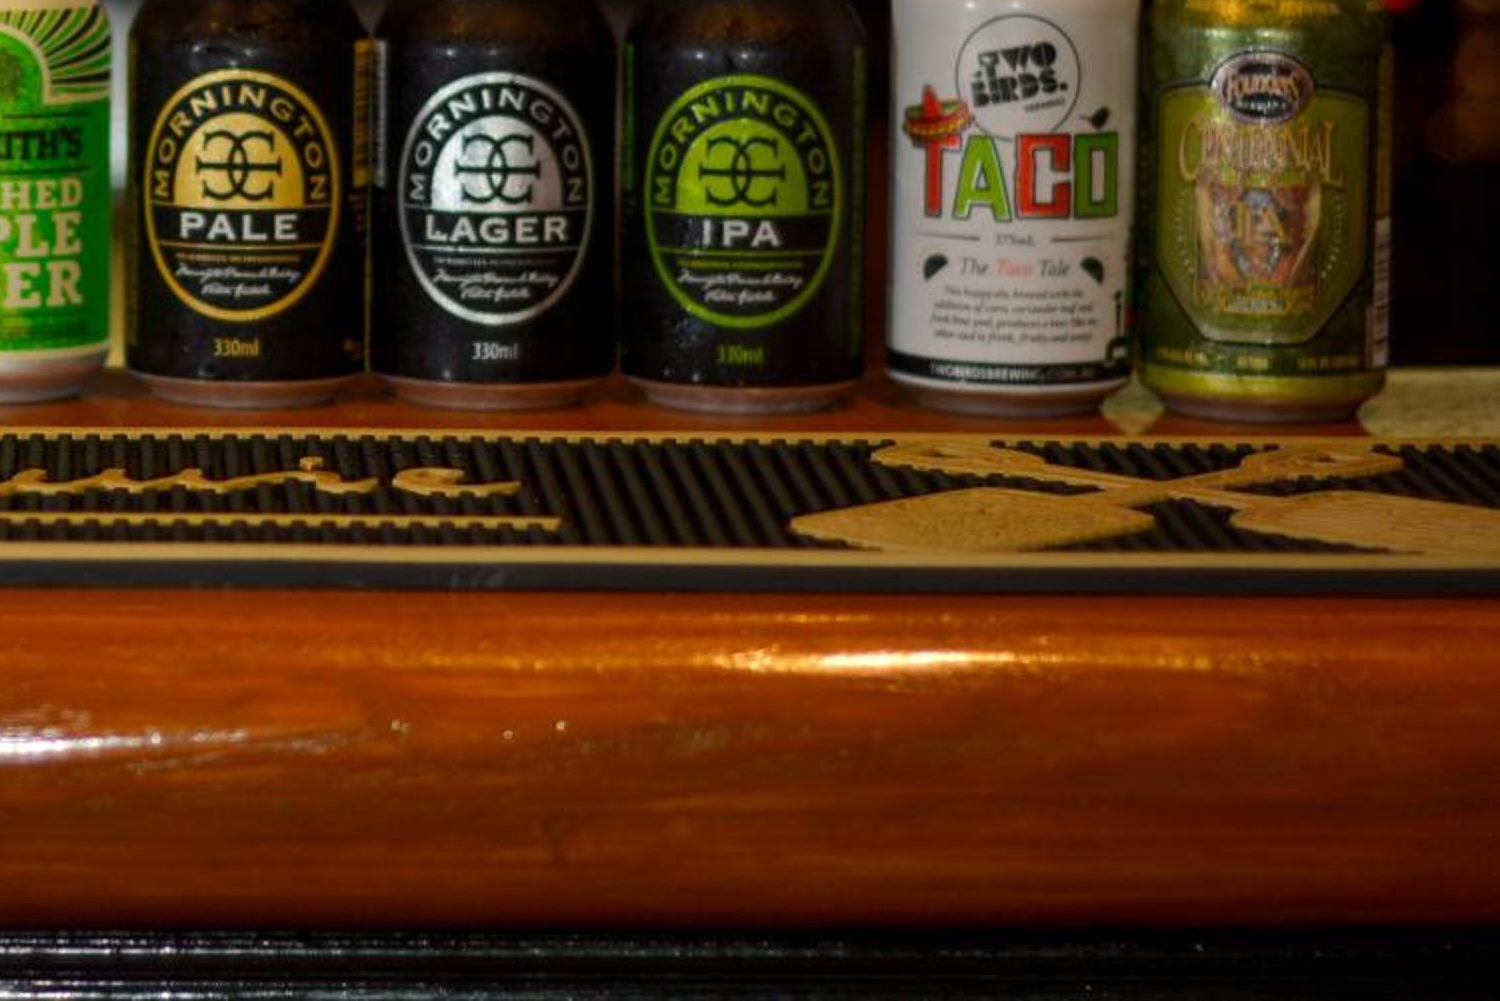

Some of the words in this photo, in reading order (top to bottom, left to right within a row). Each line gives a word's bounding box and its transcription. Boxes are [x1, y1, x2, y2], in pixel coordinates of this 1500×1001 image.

[978, 42, 1058, 79] TWO
[154, 84, 327, 199] MORNINGTON
[410, 85, 583, 201] MORNINGTON
[655, 90, 830, 206] MORNINGTON
[916, 132, 1119, 222] TACO
[180, 212, 299, 241] PALE
[425, 214, 569, 244] LAGER
[702, 220, 782, 248] IPA
[961, 257, 989, 276] The
[1038, 258, 1071, 278] Tale
[213, 338, 260, 359] 330ml
[472, 342, 519, 360] 330ml
